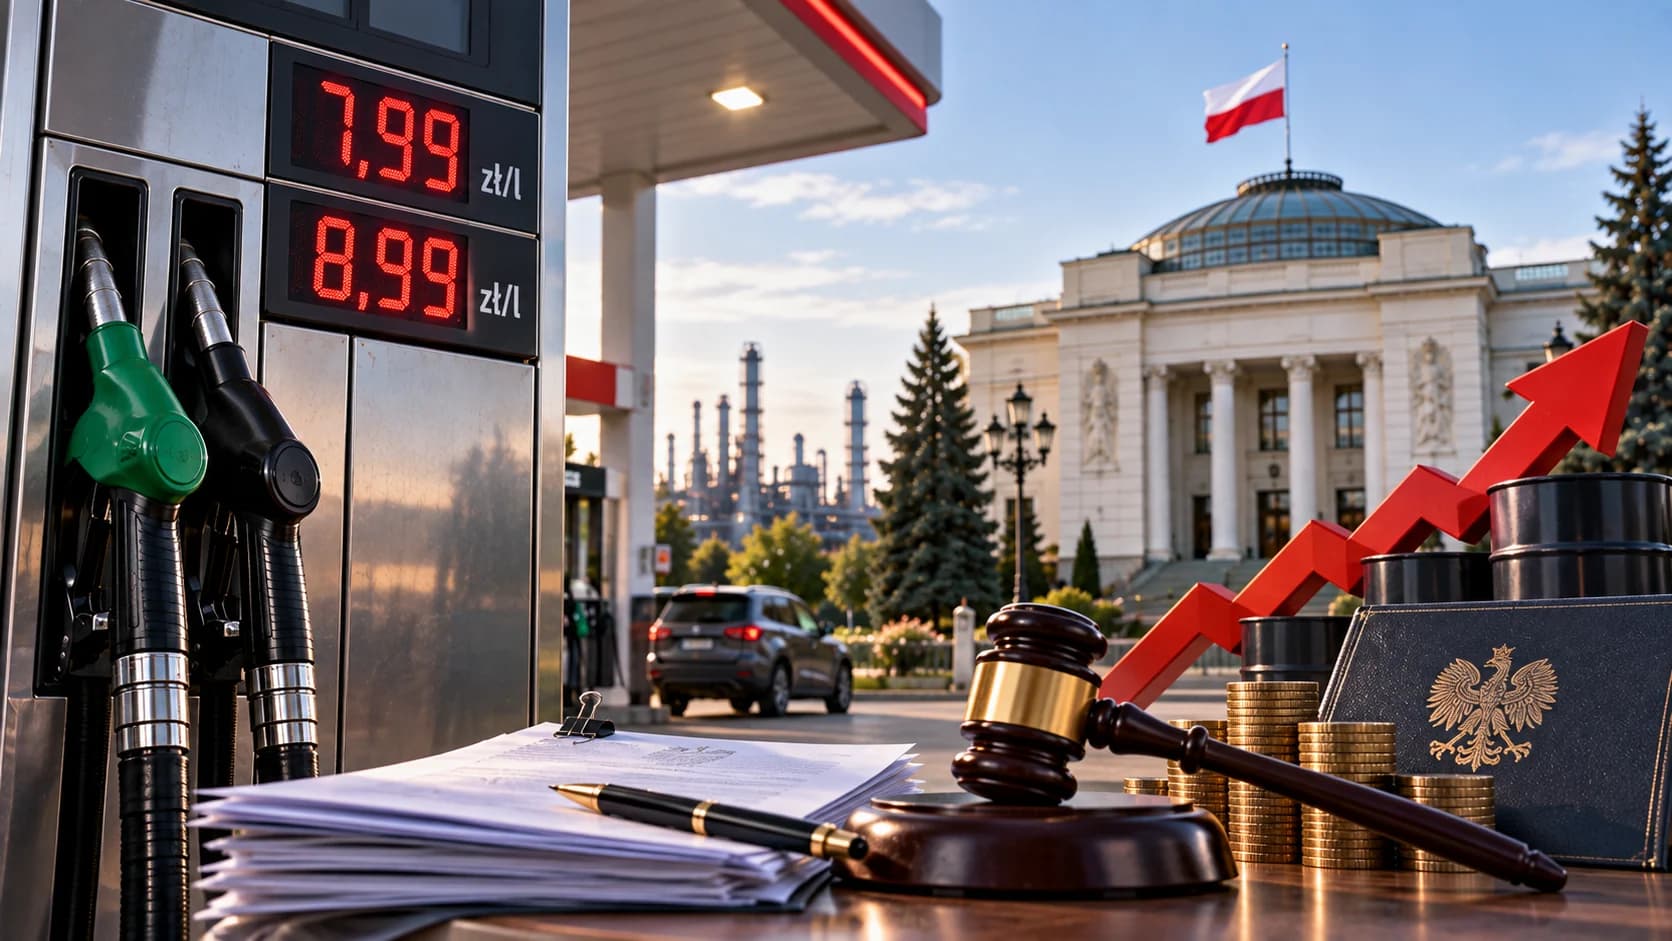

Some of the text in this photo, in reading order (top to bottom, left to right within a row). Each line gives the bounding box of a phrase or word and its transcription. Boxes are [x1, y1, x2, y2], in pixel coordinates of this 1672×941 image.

[321, 80, 522, 201] 7,99 zł/l
[313, 215, 521, 319] 8,99 zł/l
